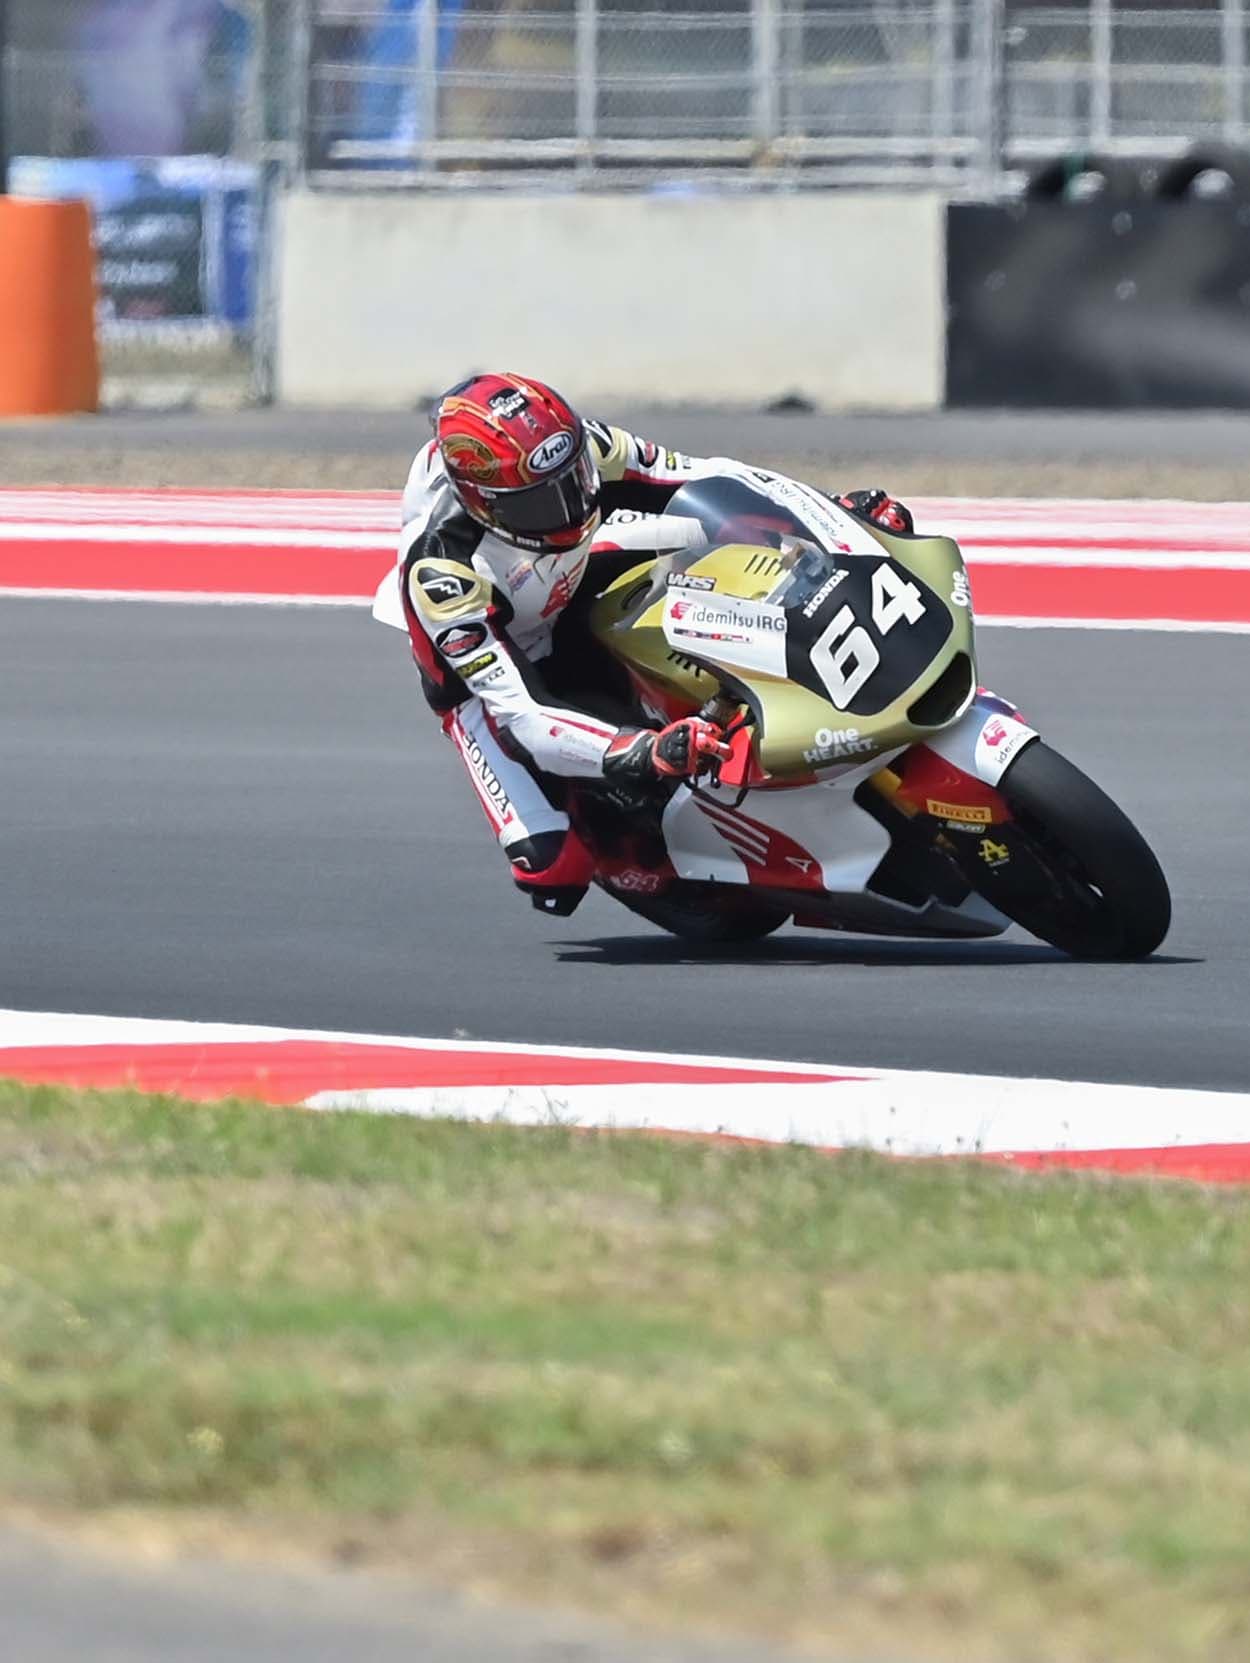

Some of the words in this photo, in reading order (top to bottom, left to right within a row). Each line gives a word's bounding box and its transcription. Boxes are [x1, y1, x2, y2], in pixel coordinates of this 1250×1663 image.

[541, 434, 568, 463] Arai
[802, 568, 850, 619] HONDA
[693, 604, 754, 628] idemitsu
[756, 613, 786, 632] IRG
[809, 562, 927, 711] 64
[815, 728, 860, 748] One
